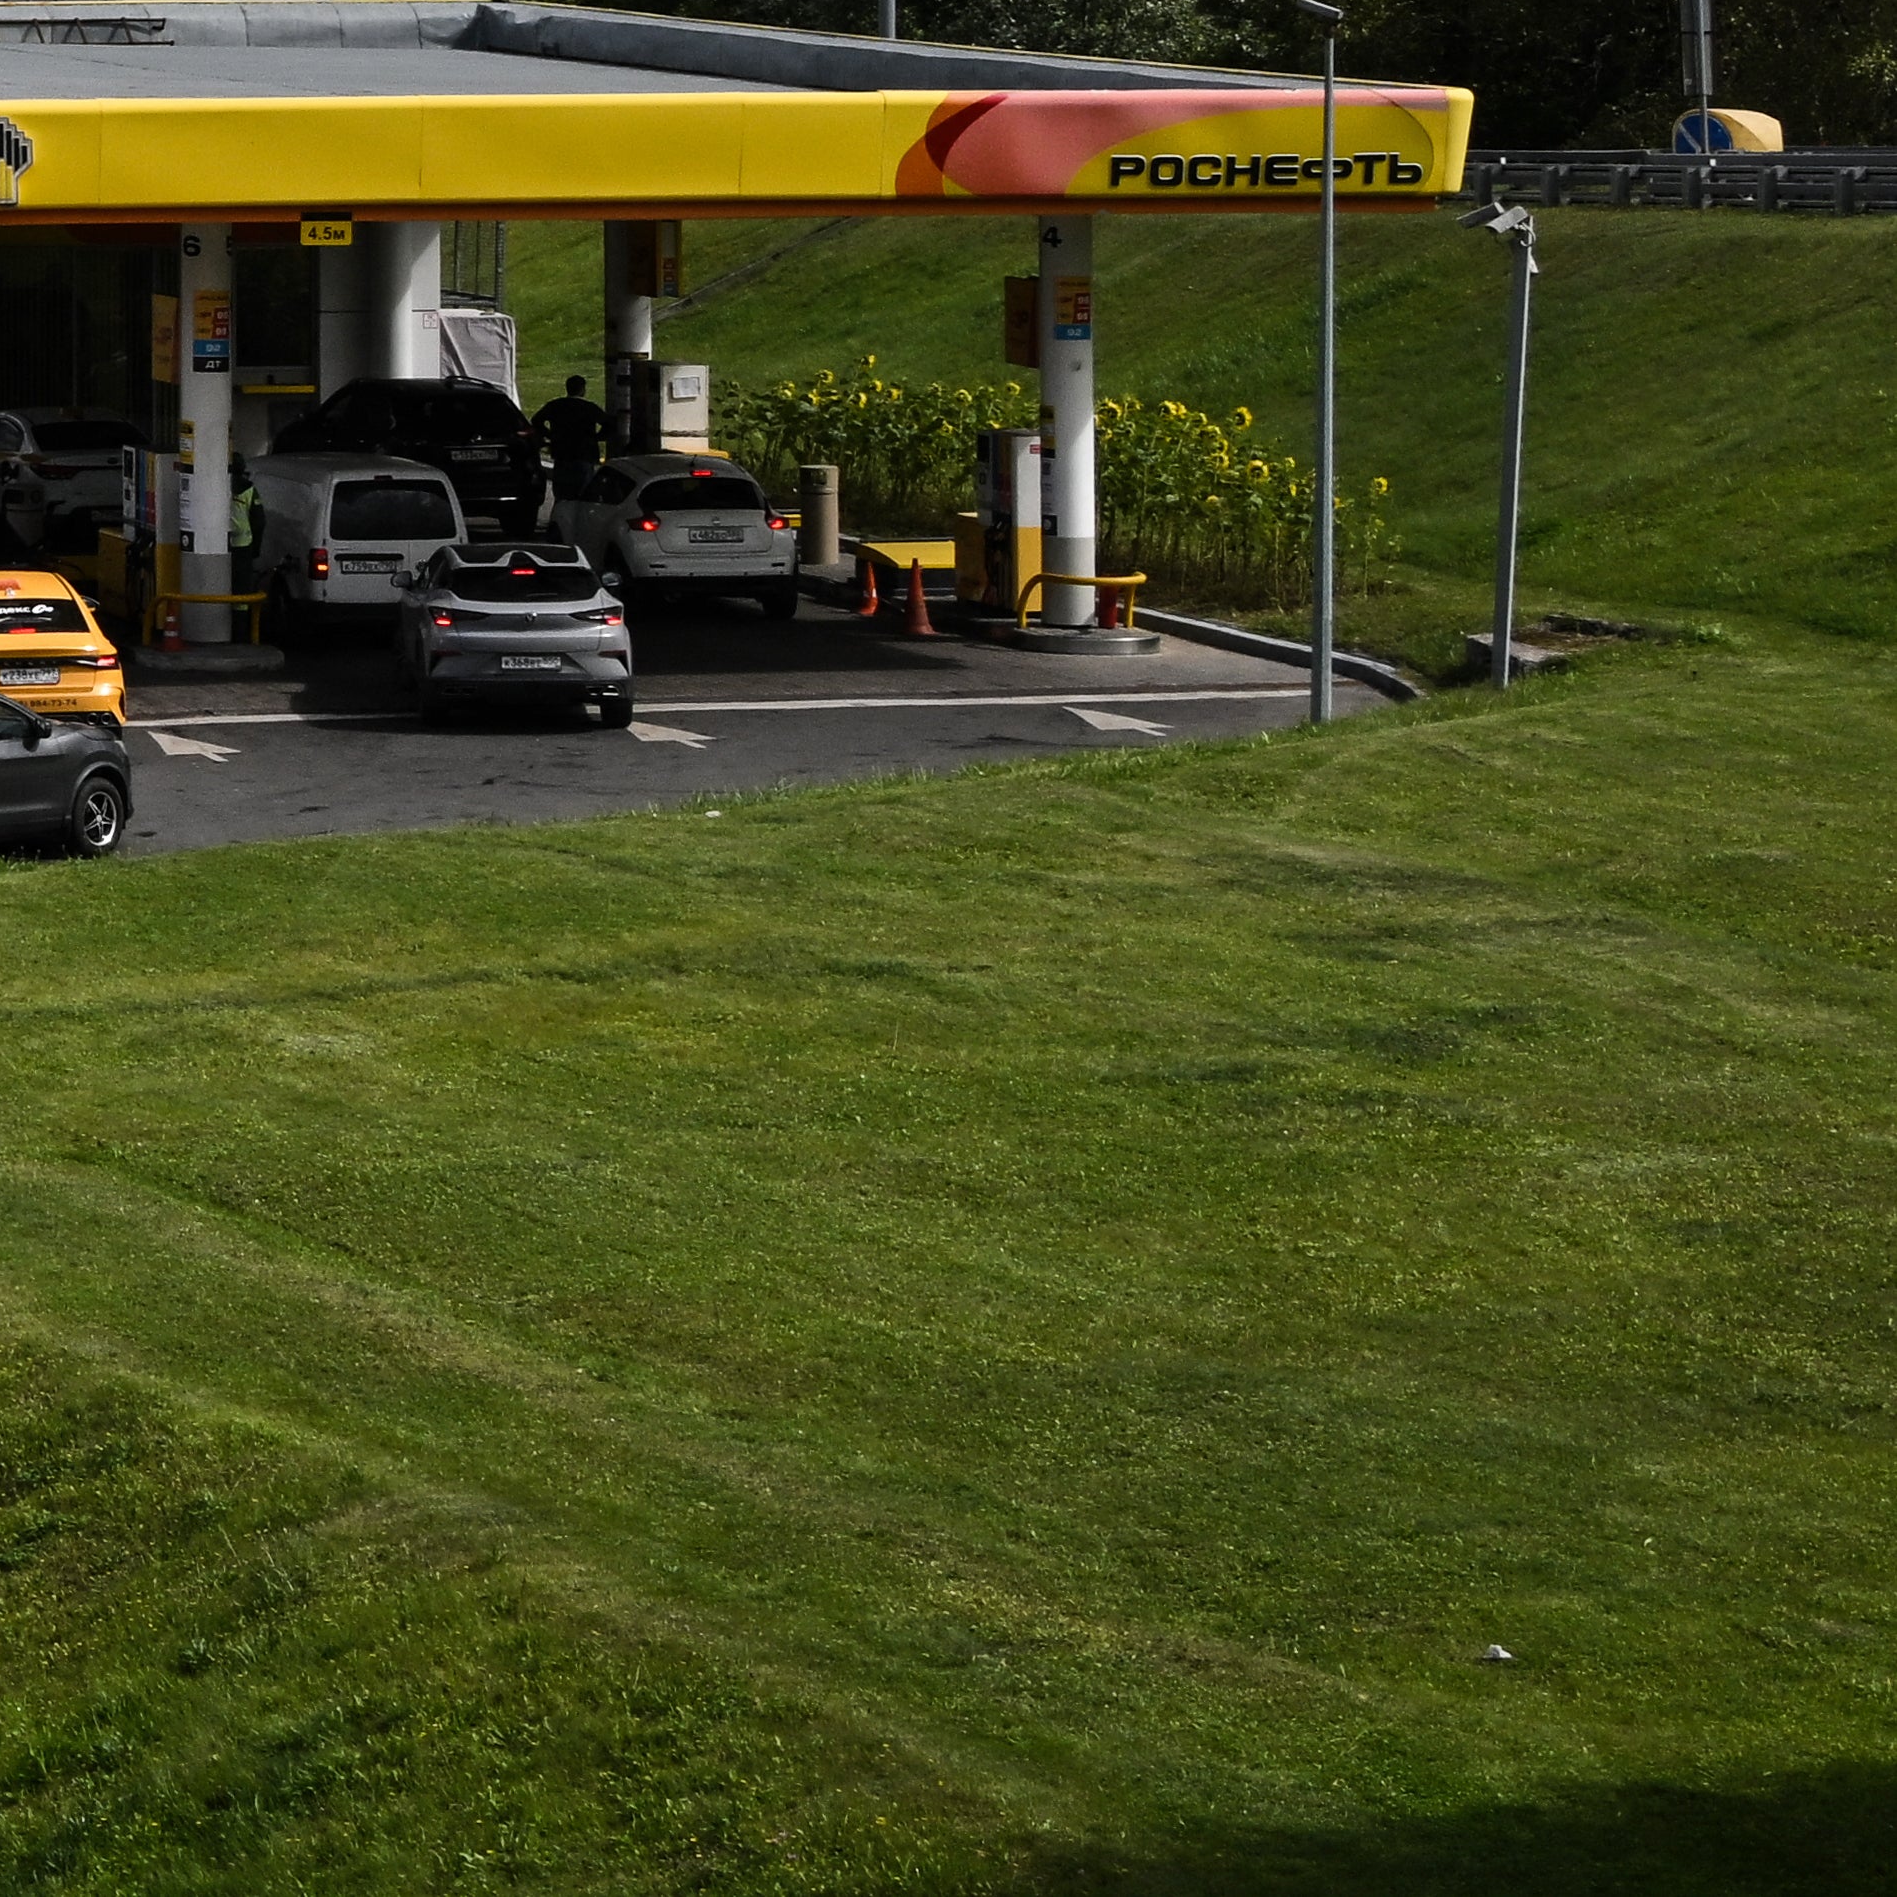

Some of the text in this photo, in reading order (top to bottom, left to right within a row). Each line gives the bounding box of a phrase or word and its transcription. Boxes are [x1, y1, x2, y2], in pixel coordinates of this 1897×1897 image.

[1110, 152, 1424, 187] РОСНЕФТЬ
[183, 236, 201, 257] 6
[1043, 227, 1062, 248] 4
[205, 360, 221, 369] ДТ
